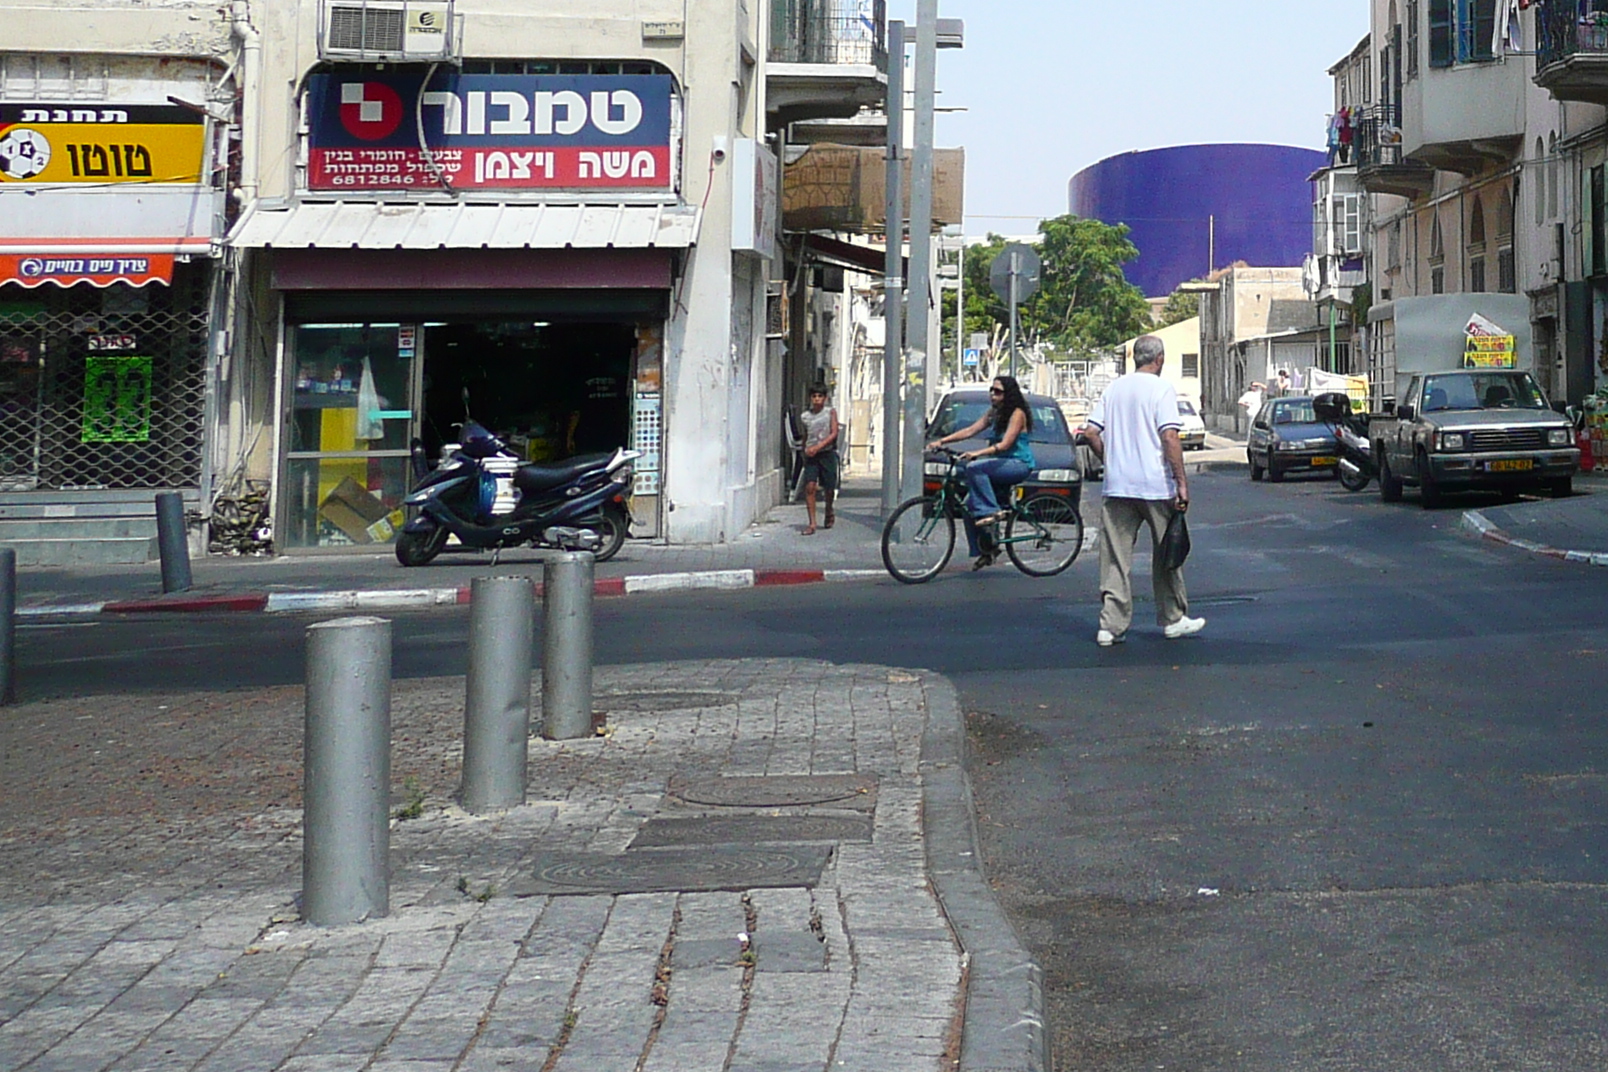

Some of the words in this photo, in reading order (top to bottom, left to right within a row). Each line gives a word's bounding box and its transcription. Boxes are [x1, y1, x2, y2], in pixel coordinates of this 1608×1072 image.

[20, 109, 128, 123] תחנת
[422, 88, 643, 135] טמבור
[66, 143, 153, 177] טוטו
[323, 150, 354, 164] בנין
[359, 150, 406, 161] חומרי
[324, 163, 399, 174] מפתחות
[474, 151, 555, 183] ויצמן
[578, 150, 656, 179] משה
[331, 174, 415, 185] 6812846
[44, 259, 84, 274] בחיים
[89, 259, 114, 274] פיס
[117, 259, 147, 275] צריך
